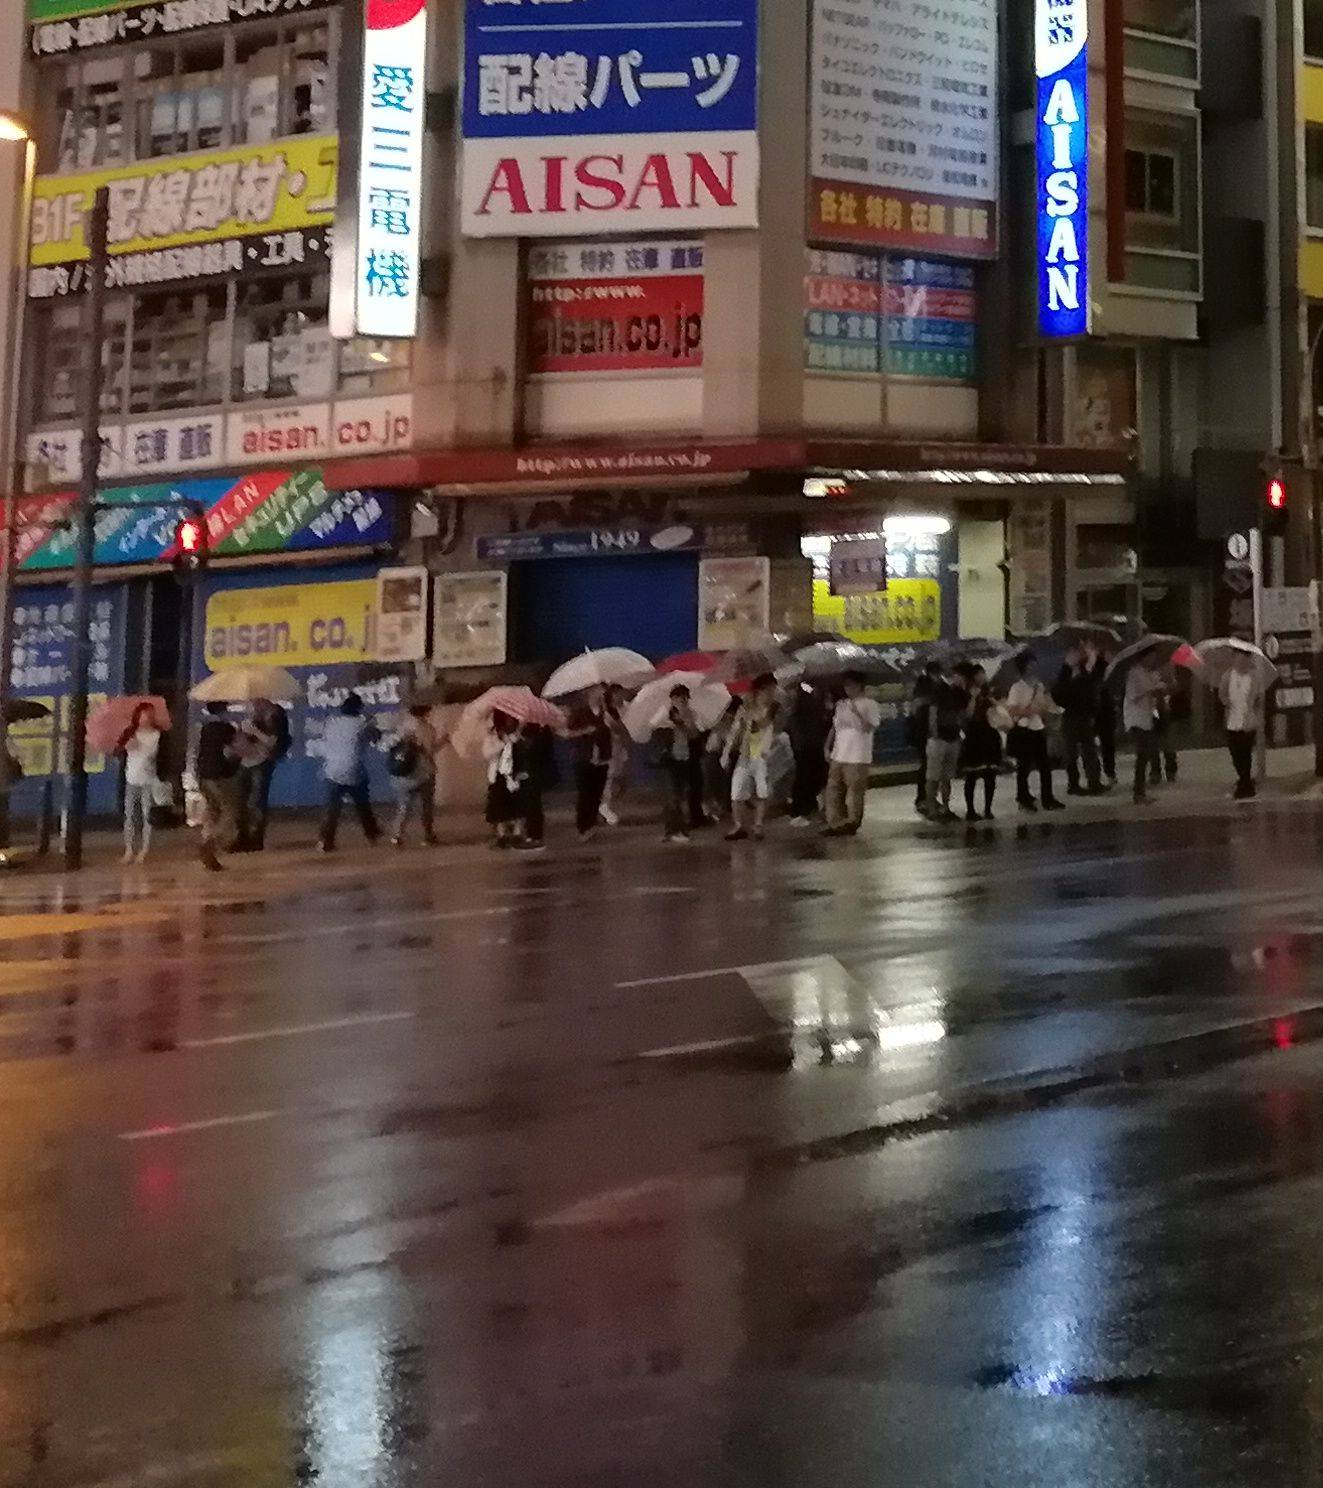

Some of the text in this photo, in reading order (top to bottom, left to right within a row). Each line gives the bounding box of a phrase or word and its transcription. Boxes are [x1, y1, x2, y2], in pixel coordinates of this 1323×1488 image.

[477, 48, 741, 116] 配線パーツ
[475, 150, 739, 216] AISAN
[1045, 78, 1081, 311] AISAN
